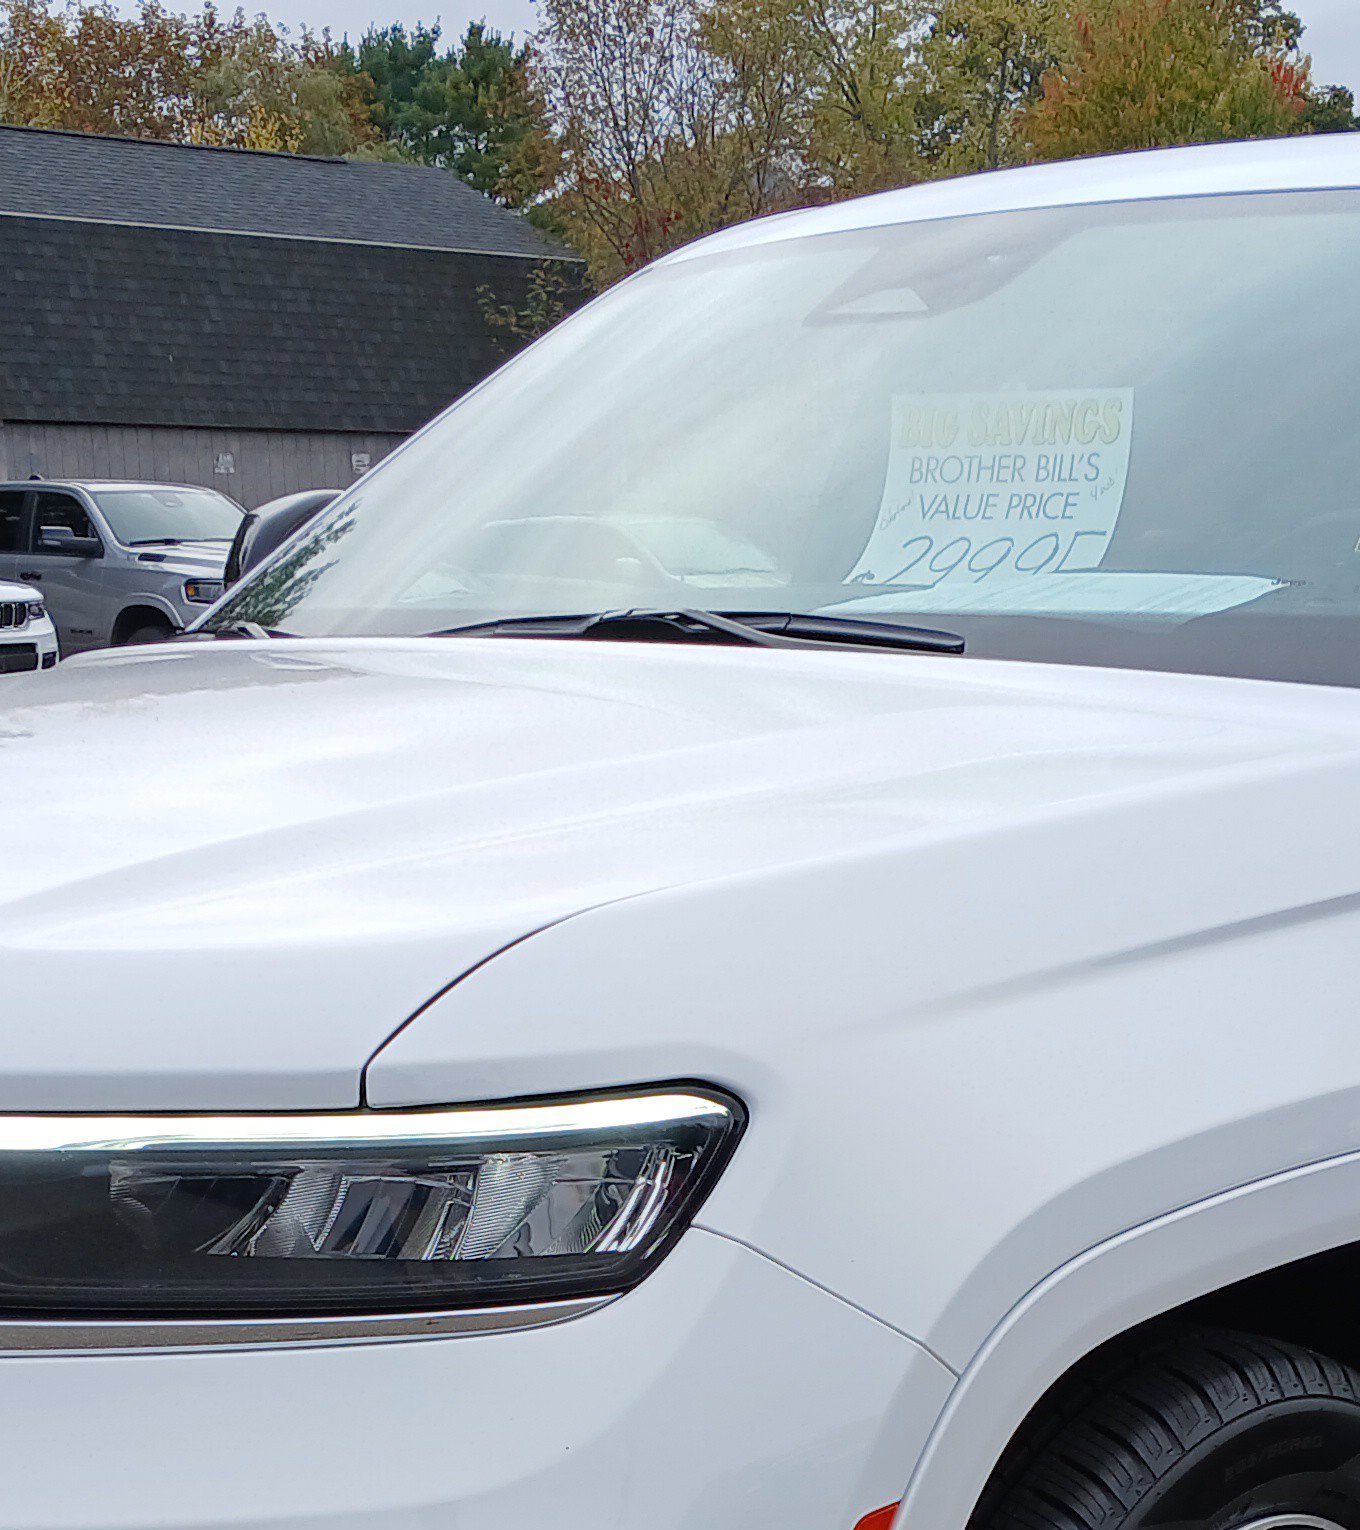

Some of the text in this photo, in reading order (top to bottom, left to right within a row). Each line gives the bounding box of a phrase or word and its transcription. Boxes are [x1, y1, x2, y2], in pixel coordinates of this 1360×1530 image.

[900, 398, 1123, 449] BIG SAVINGS
[909, 452, 1100, 484] BROTHER BILL'S
[919, 491, 1080, 521] VALUE PRICE
